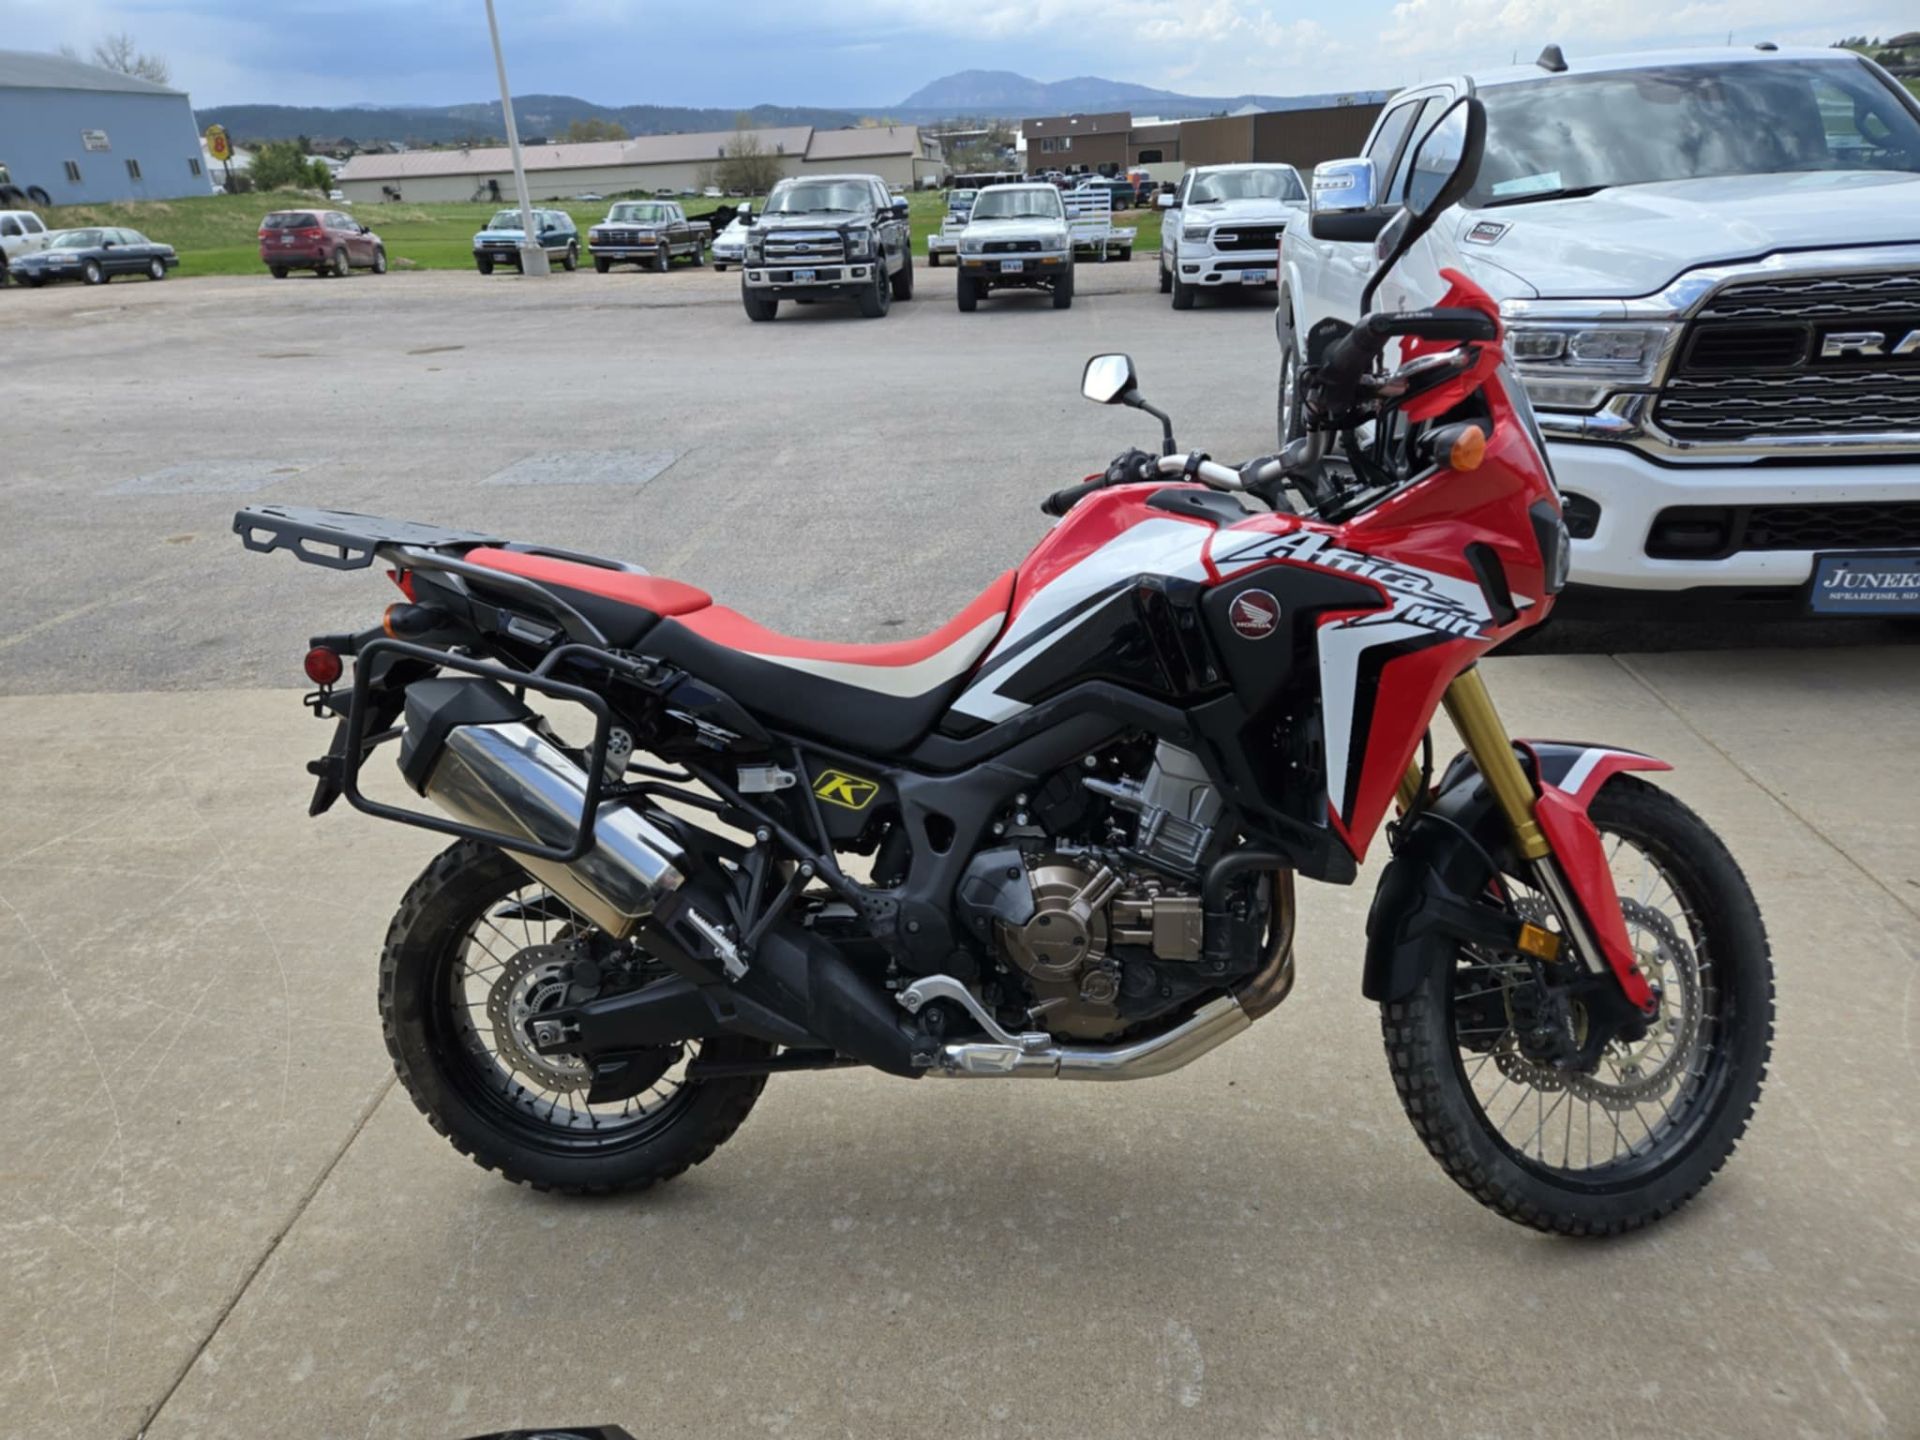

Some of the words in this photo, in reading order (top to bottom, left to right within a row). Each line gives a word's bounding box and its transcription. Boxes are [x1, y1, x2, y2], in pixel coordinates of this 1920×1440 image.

[214, 135, 225, 152] 8
[1224, 529, 1430, 597] Africa
[1823, 569, 1920, 588] JUNEK
[1351, 597, 1486, 641] Twin
